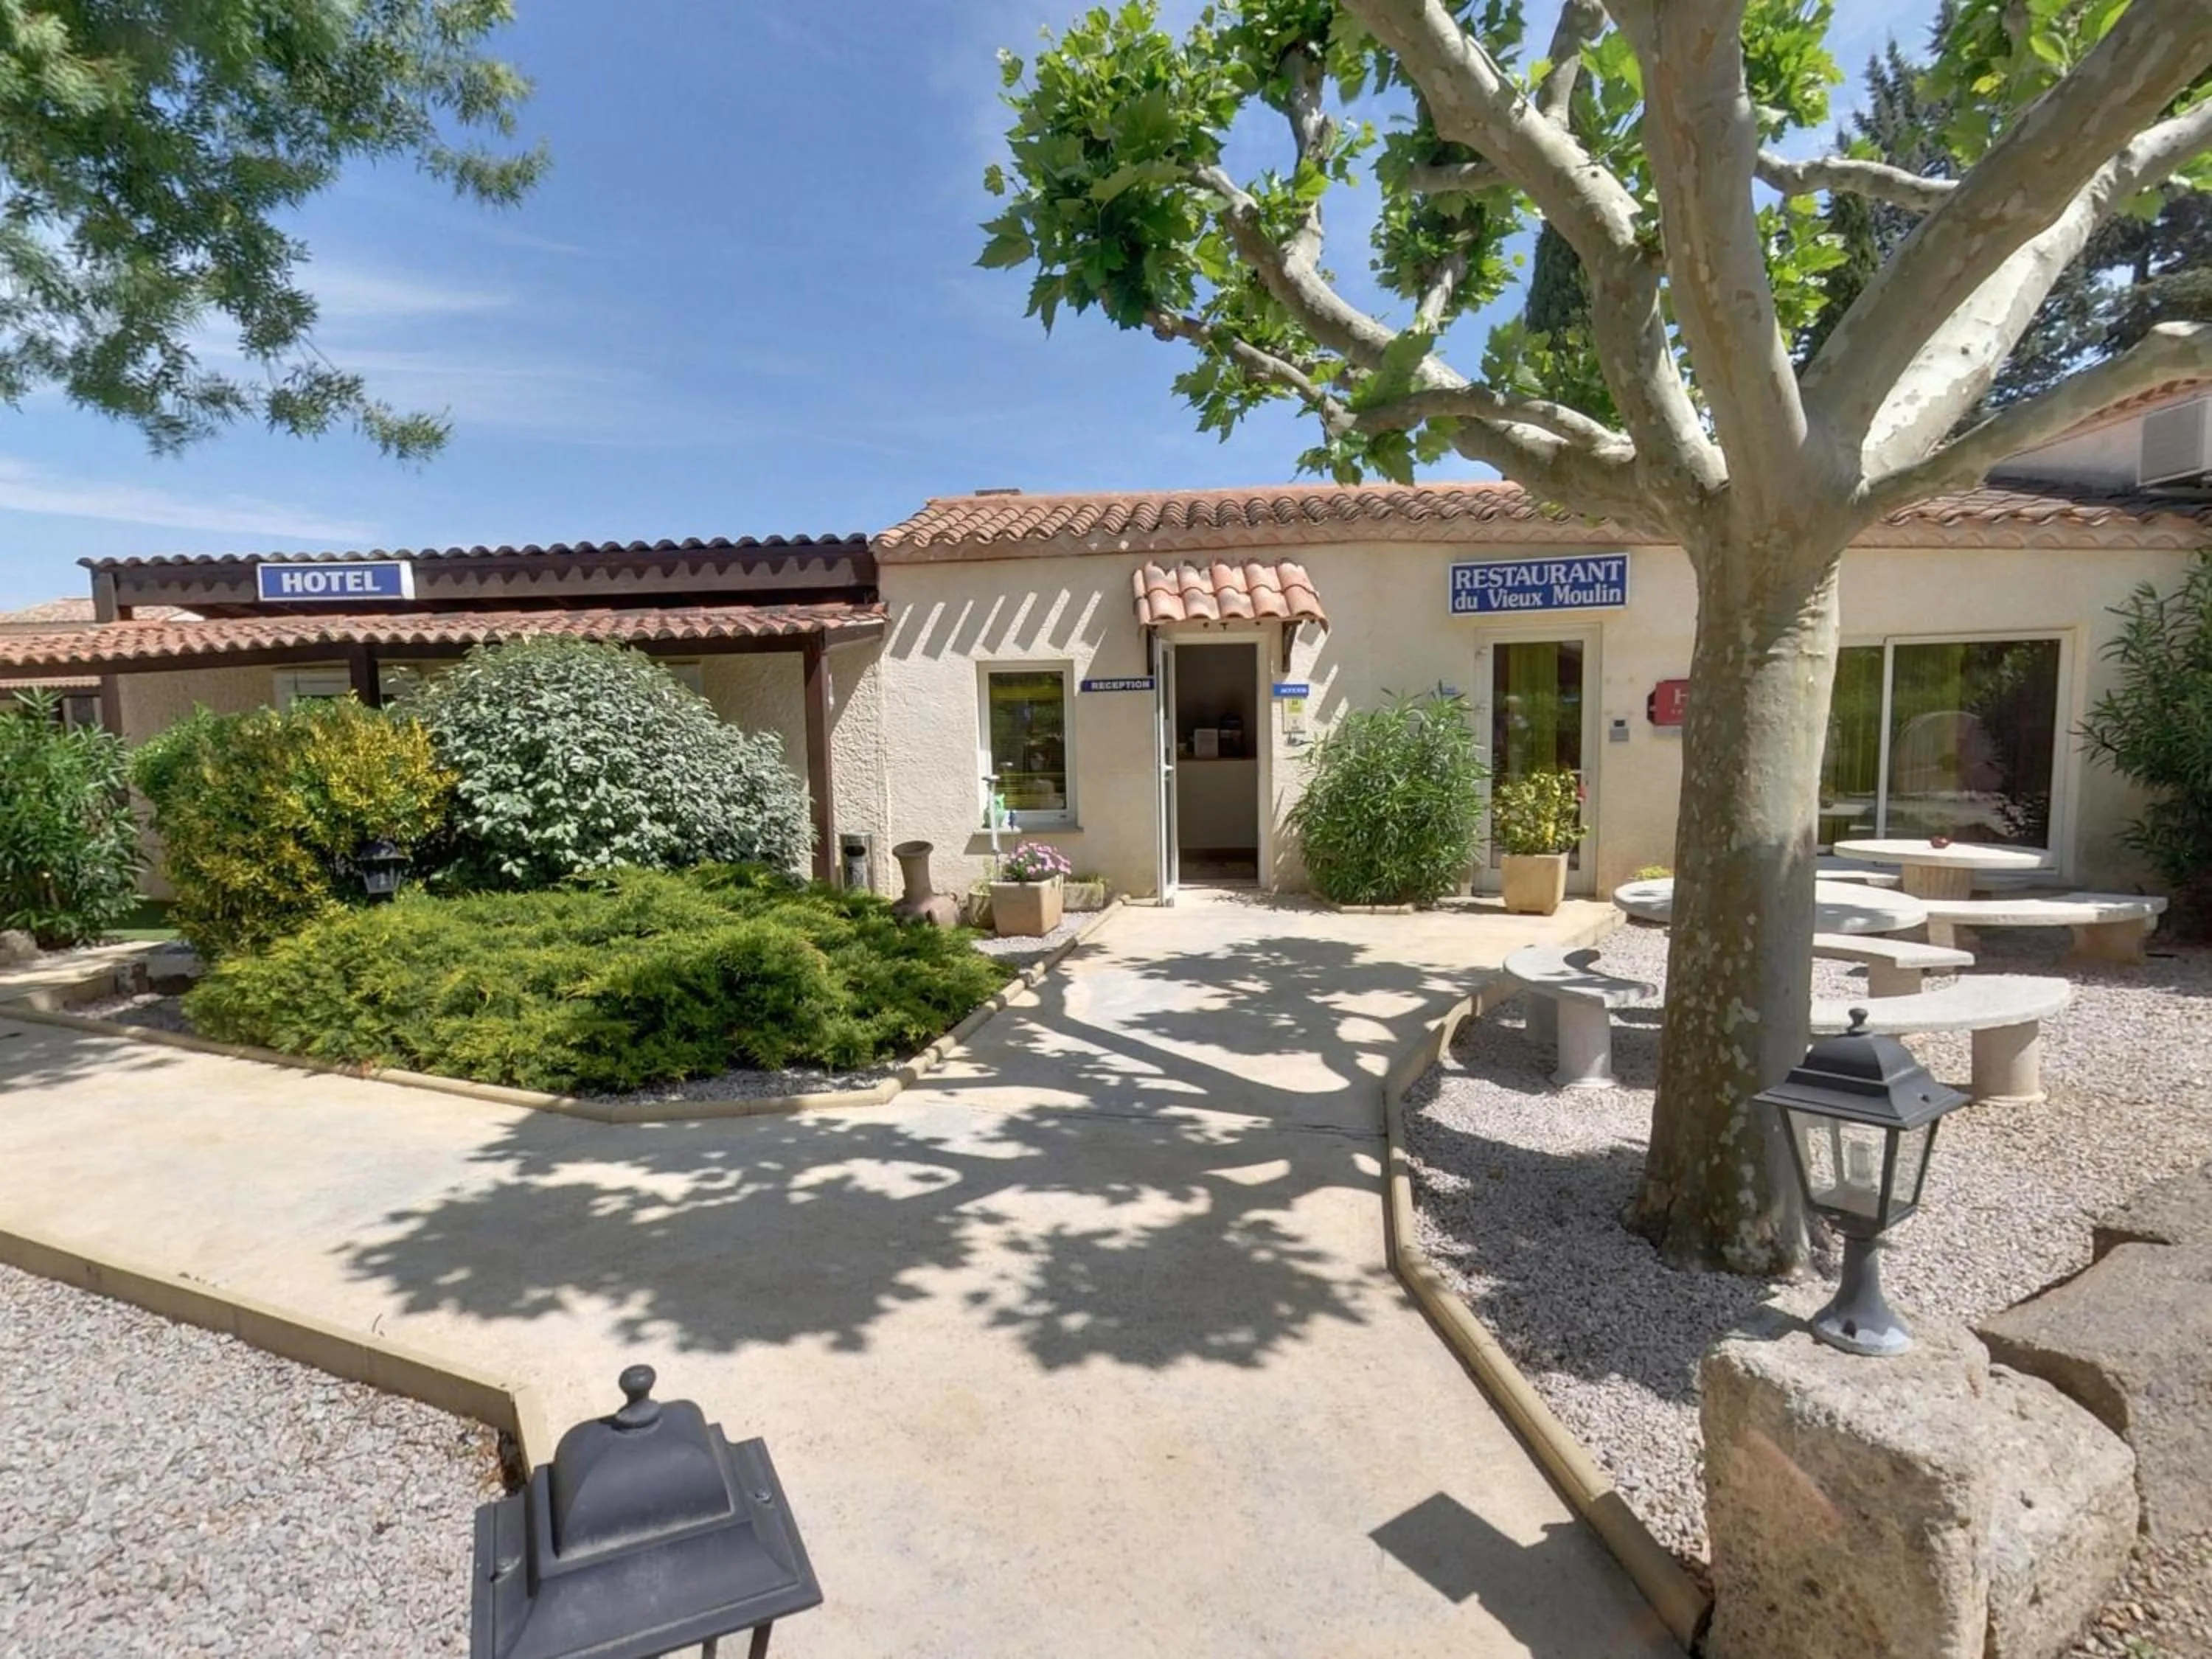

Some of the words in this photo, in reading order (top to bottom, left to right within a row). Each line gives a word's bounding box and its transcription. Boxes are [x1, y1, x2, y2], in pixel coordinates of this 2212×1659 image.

[282, 571, 381, 593] HOTEL
[1455, 561, 1623, 590] RESTAURANT
[1455, 591, 1478, 611] du
[1487, 588, 1543, 609] Vieux
[1552, 583, 1622, 605] Moulin
[1091, 681, 1150, 689] RECEPTION
